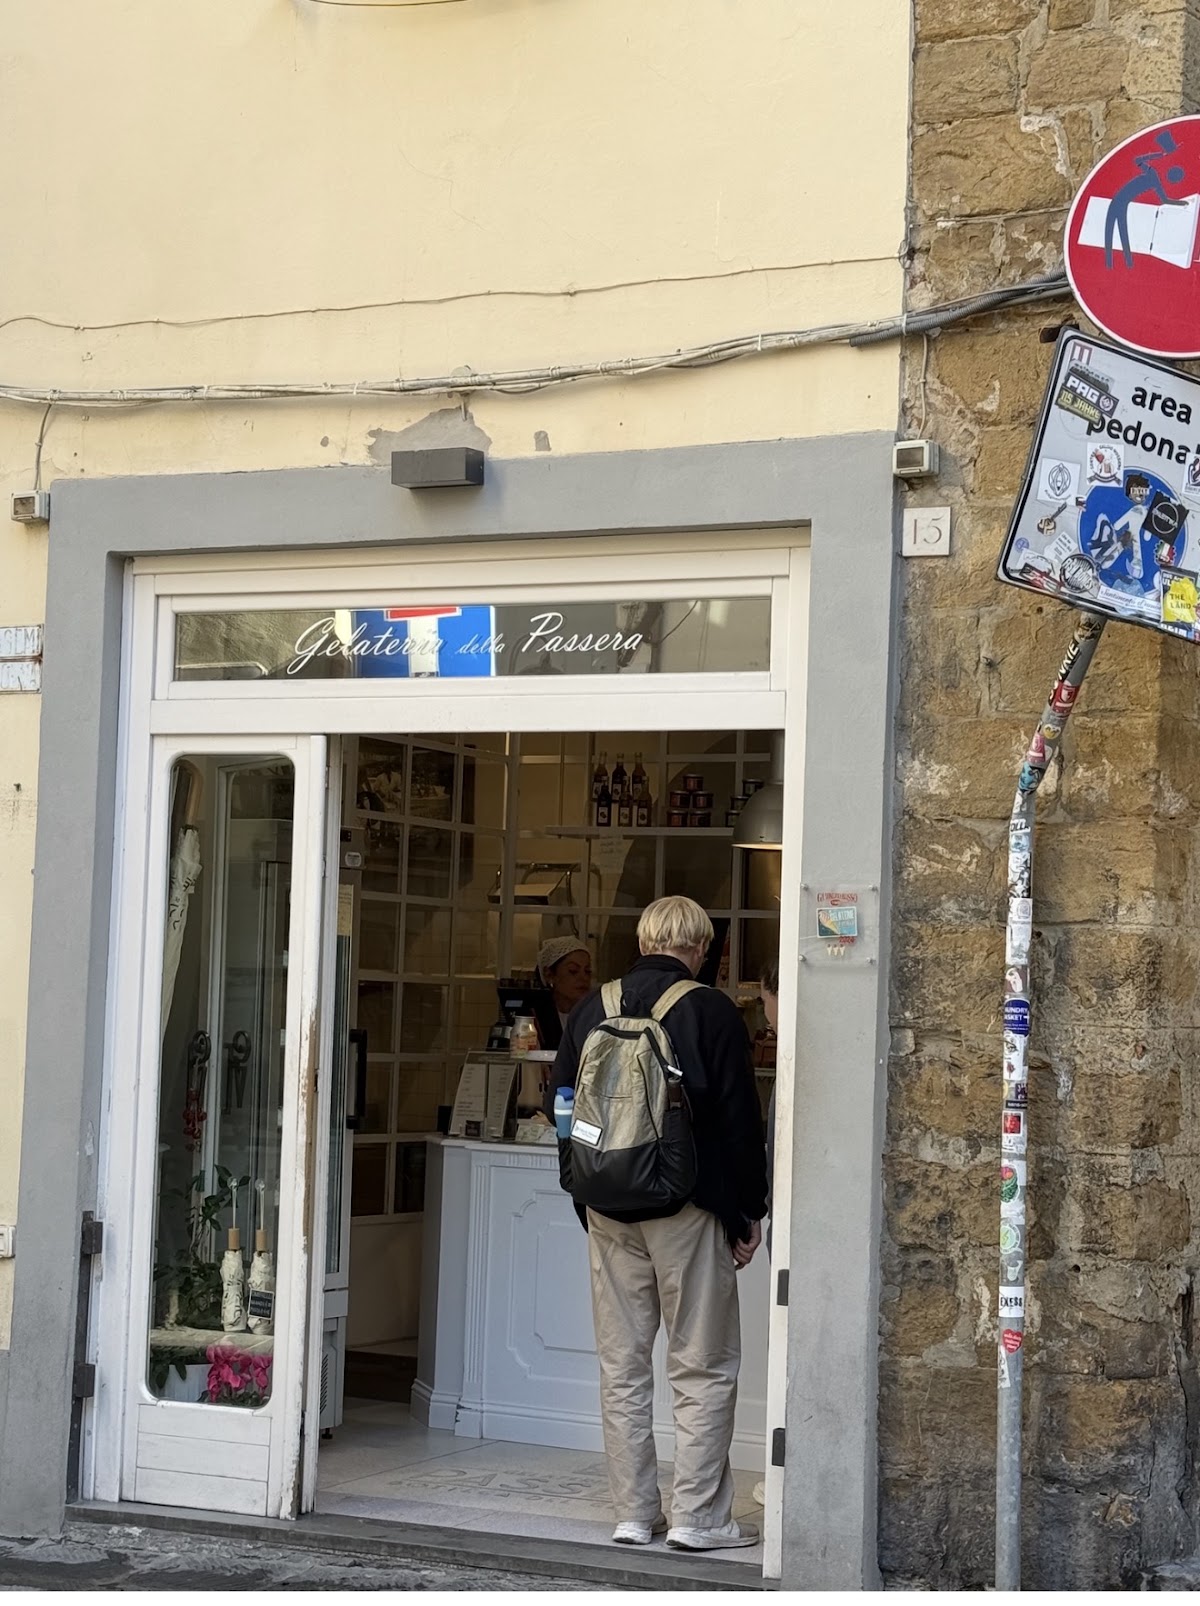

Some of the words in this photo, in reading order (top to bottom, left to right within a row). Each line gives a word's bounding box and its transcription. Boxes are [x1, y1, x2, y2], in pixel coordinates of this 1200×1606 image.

[1066, 375, 1100, 403] PAG
[1131, 386, 1192, 425] area
[913, 515, 944, 545] 15
[287, 617, 443, 675] Gelateria
[456, 633, 506, 655] della
[522, 612, 644, 653] Passera
